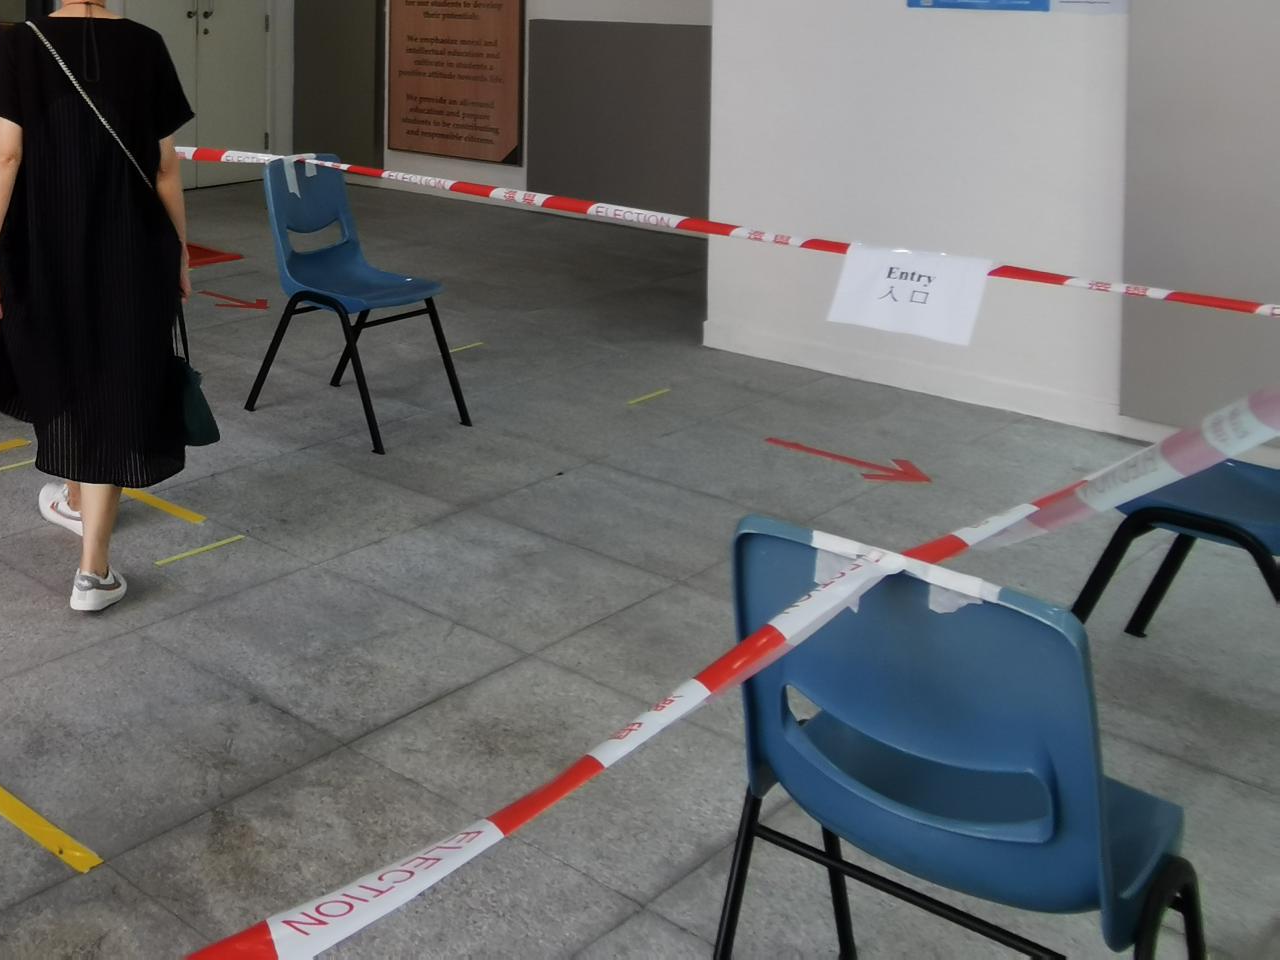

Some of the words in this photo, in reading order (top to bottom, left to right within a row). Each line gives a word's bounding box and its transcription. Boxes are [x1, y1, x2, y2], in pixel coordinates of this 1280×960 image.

[595, 205, 672, 229] ELECTION
[887, 266, 936, 287] Entry
[877, 285, 930, 304] 入口
[280, 829, 485, 937] ELECTION
